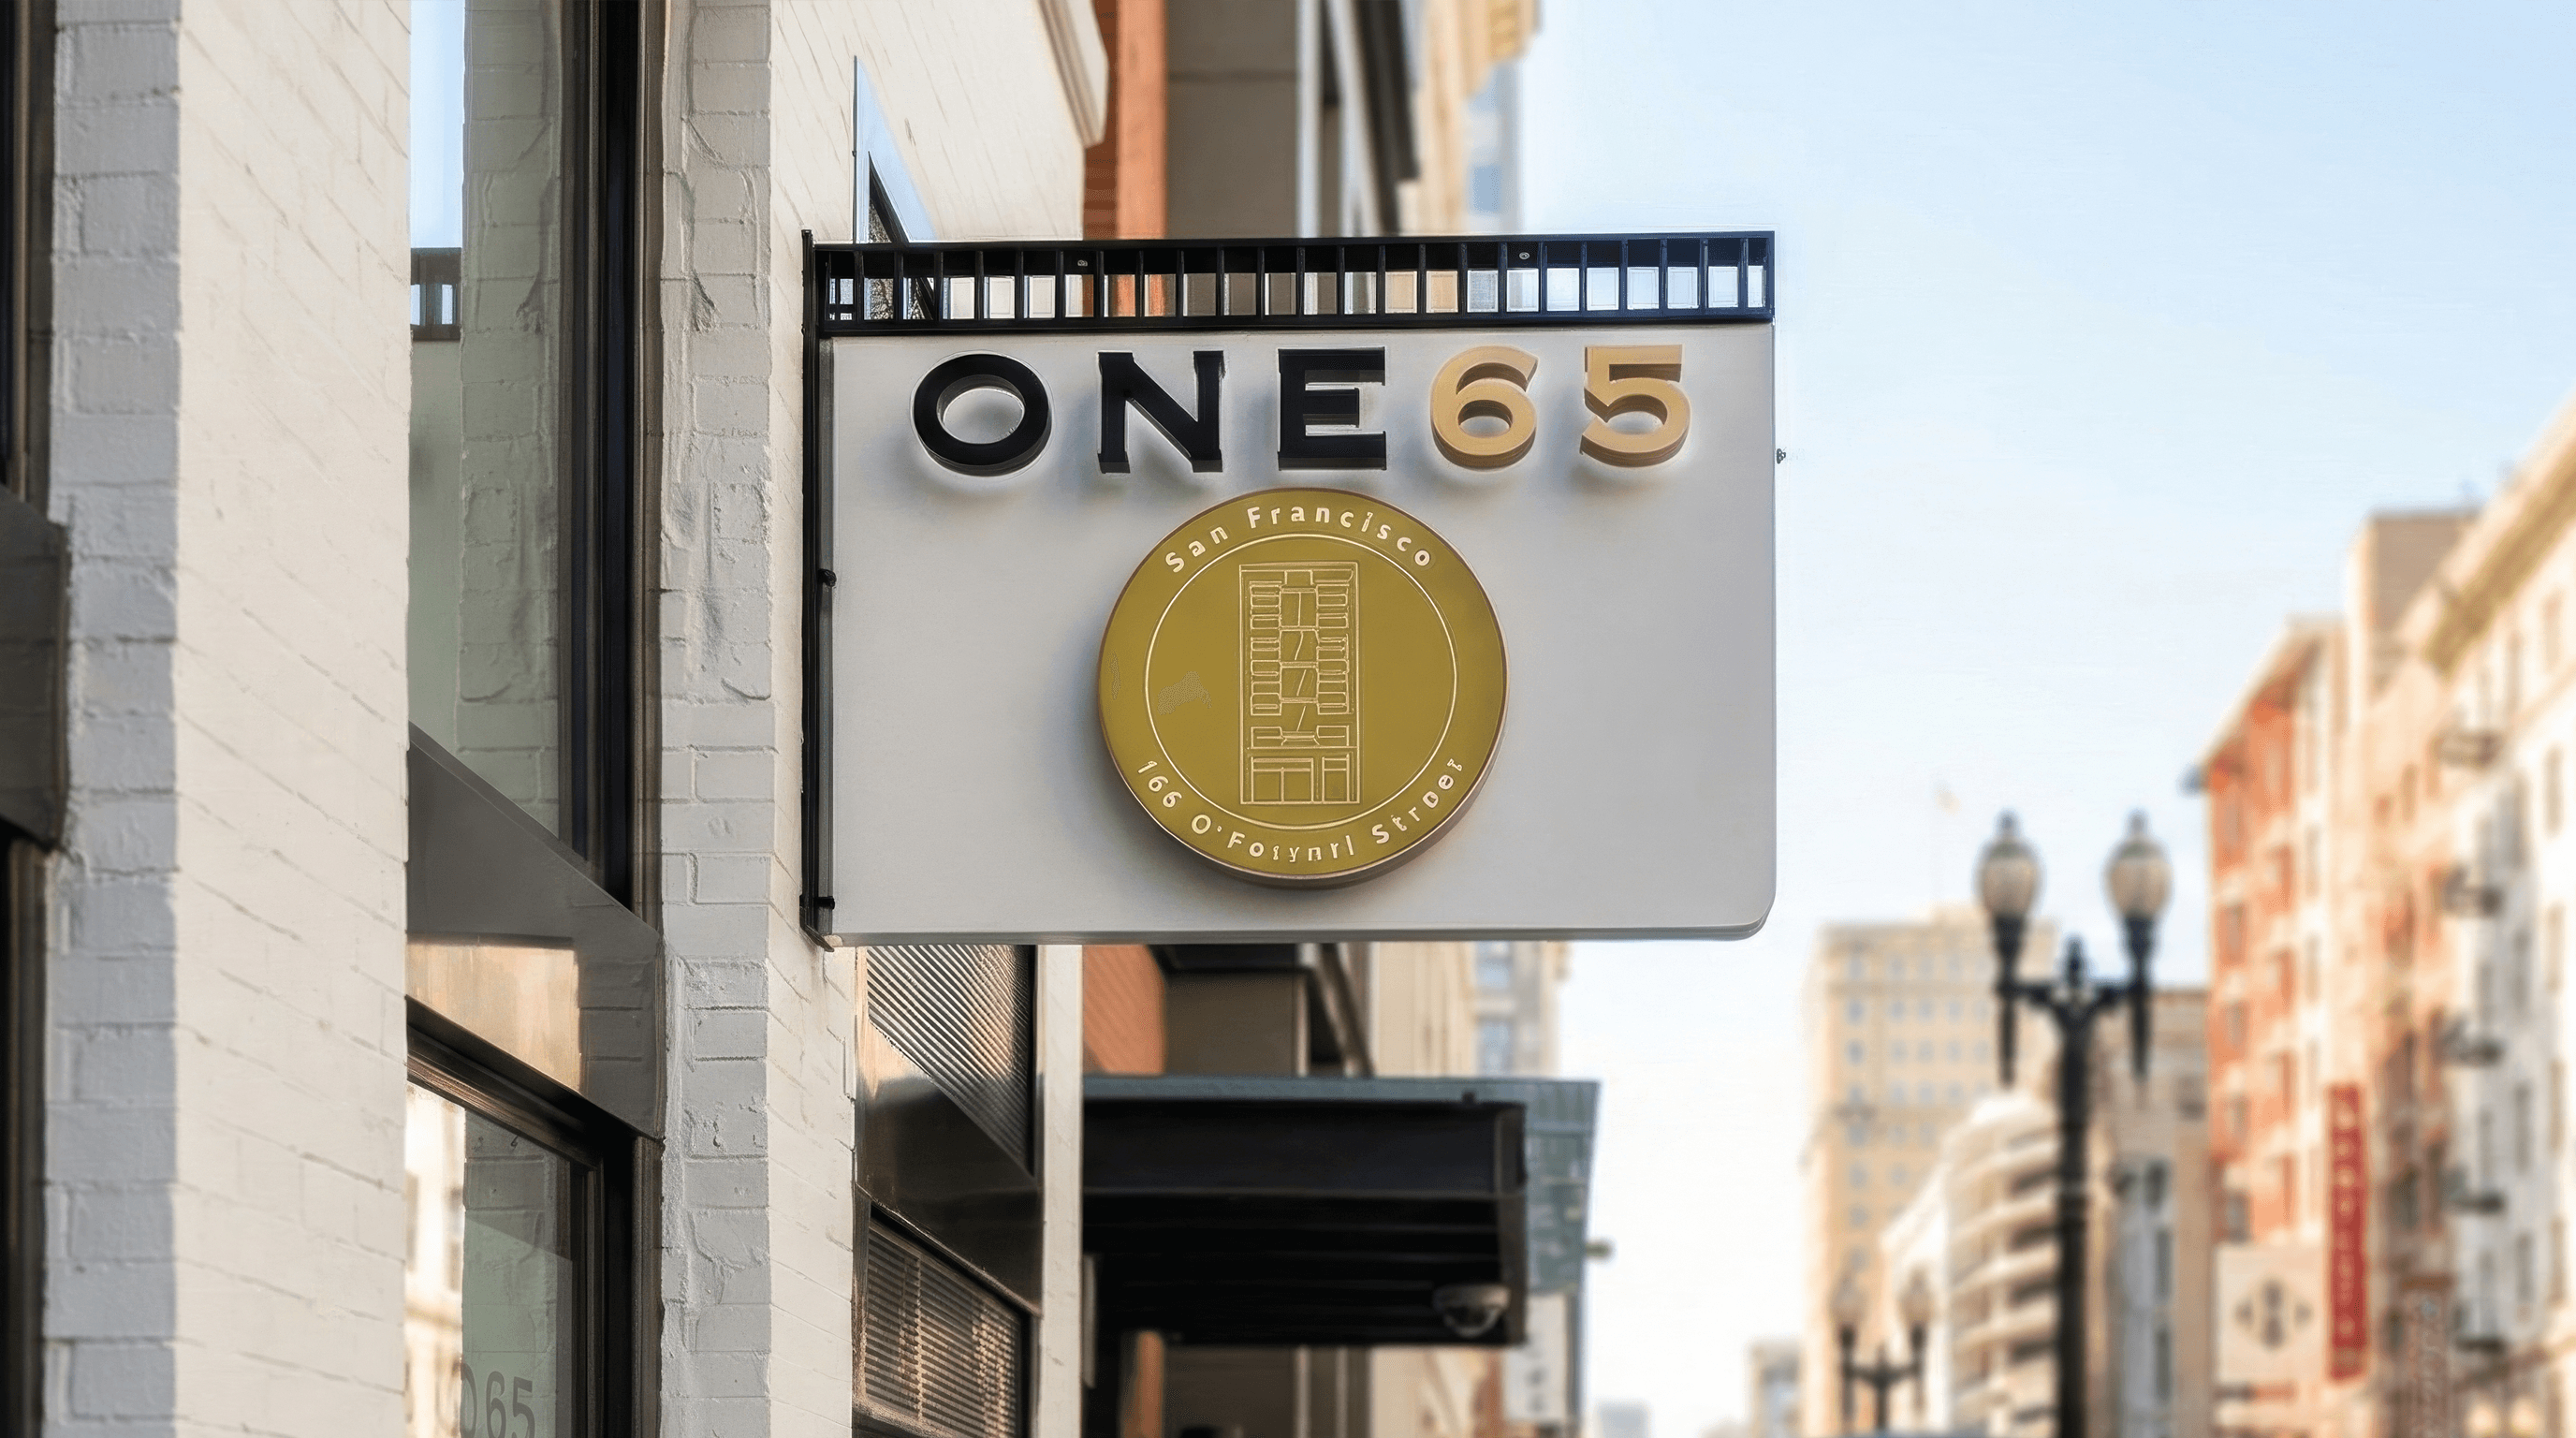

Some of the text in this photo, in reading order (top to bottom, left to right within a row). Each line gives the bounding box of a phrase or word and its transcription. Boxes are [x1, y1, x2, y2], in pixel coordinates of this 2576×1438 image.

[1165, 506, 1430, 573] San Francisco
[1137, 760, 1182, 808] 166
